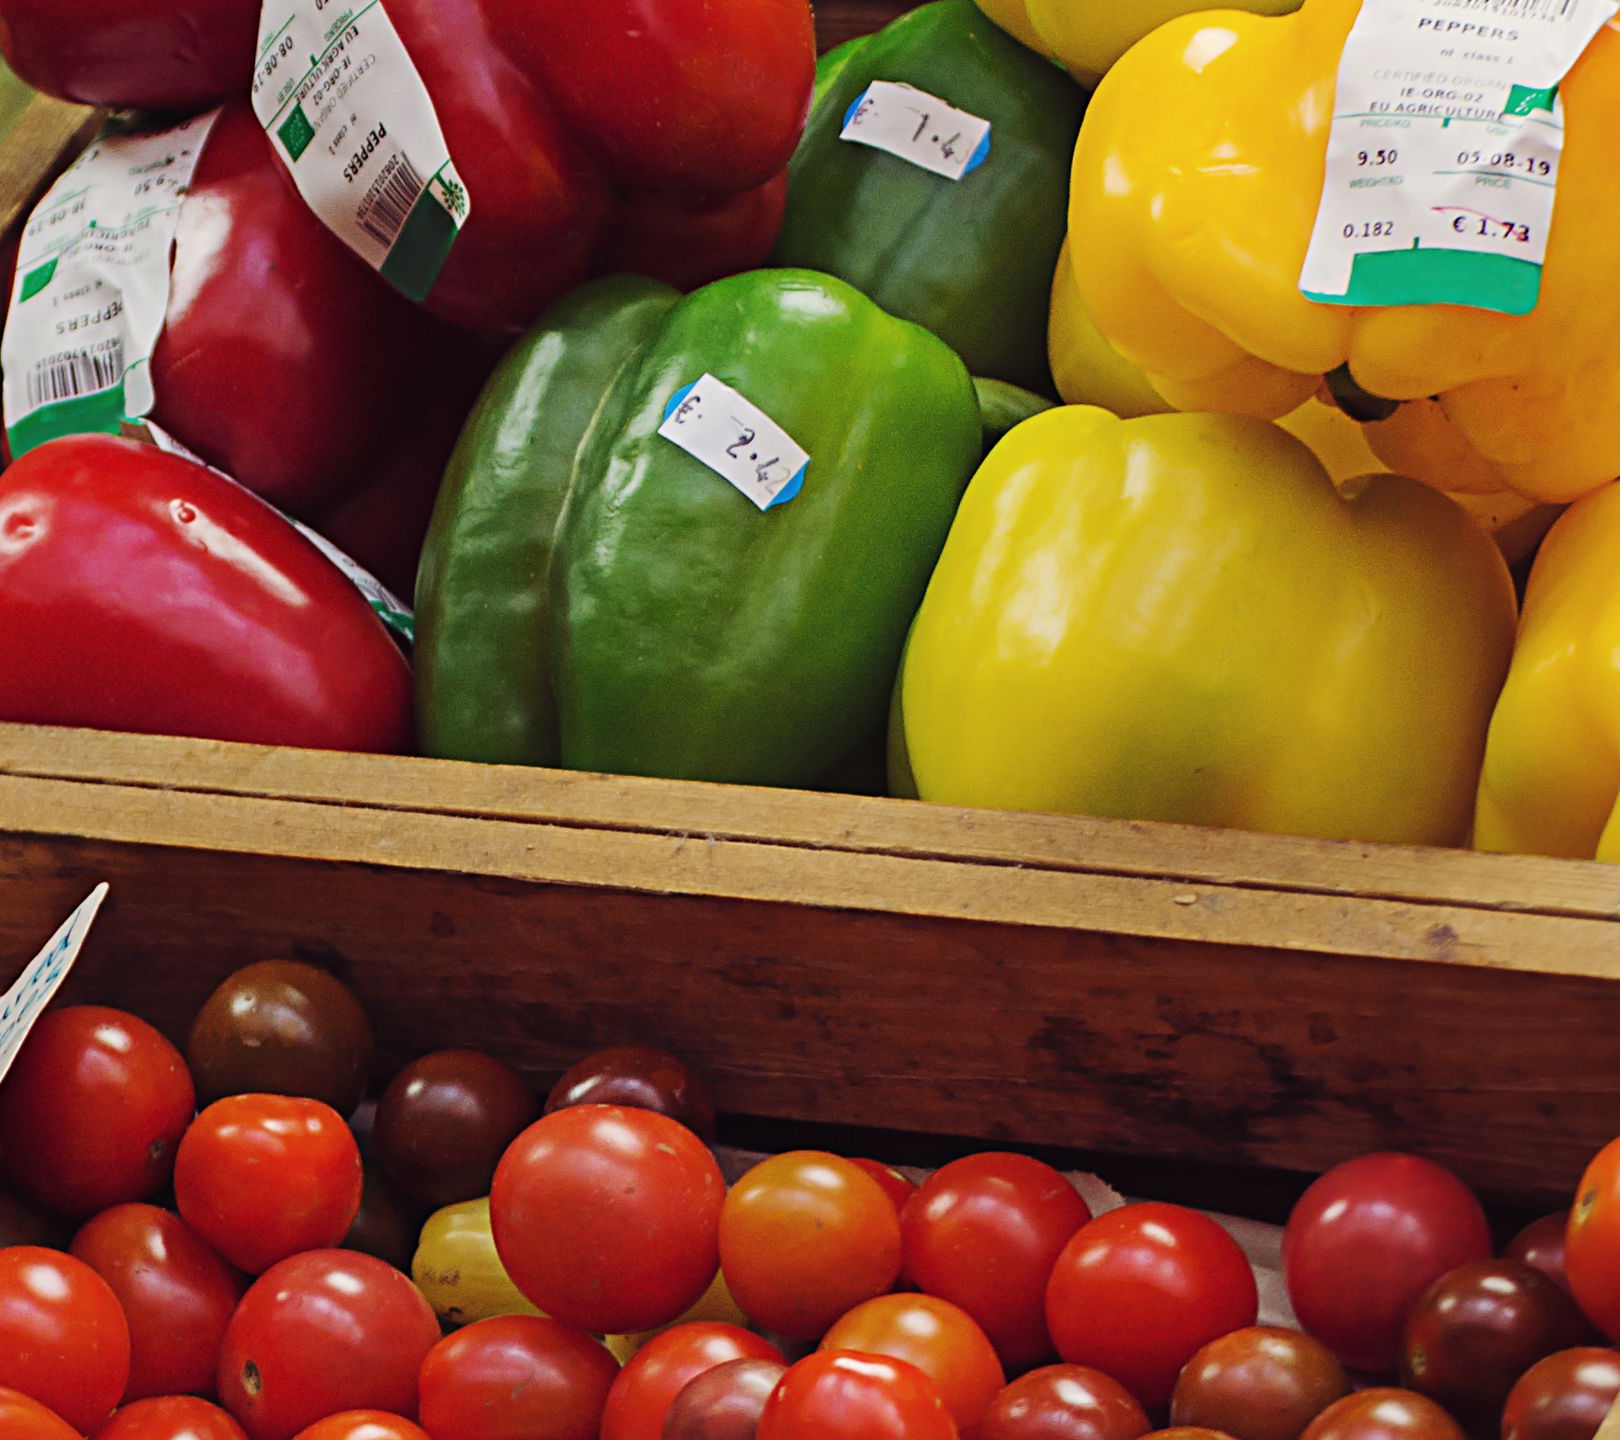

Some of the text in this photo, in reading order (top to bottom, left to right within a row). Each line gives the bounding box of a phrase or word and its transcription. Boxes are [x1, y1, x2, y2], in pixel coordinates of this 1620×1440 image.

[343, 25, 360, 45] EU
[1418, 17, 1520, 41] PEPPERS
[313, 55, 352, 106] IE-ORG-02
[1372, 69, 1447, 85] CERTIFIED
[1400, 87, 1484, 103] IE-ORG-02
[1369, 102, 1390, 113] EU
[343, 121, 387, 183] PEPPERS
[1357, 149, 1398, 166] 9.50
[1343, 221, 1394, 239] 0.182
[1453, 216, 1530, 242] € 1.73
